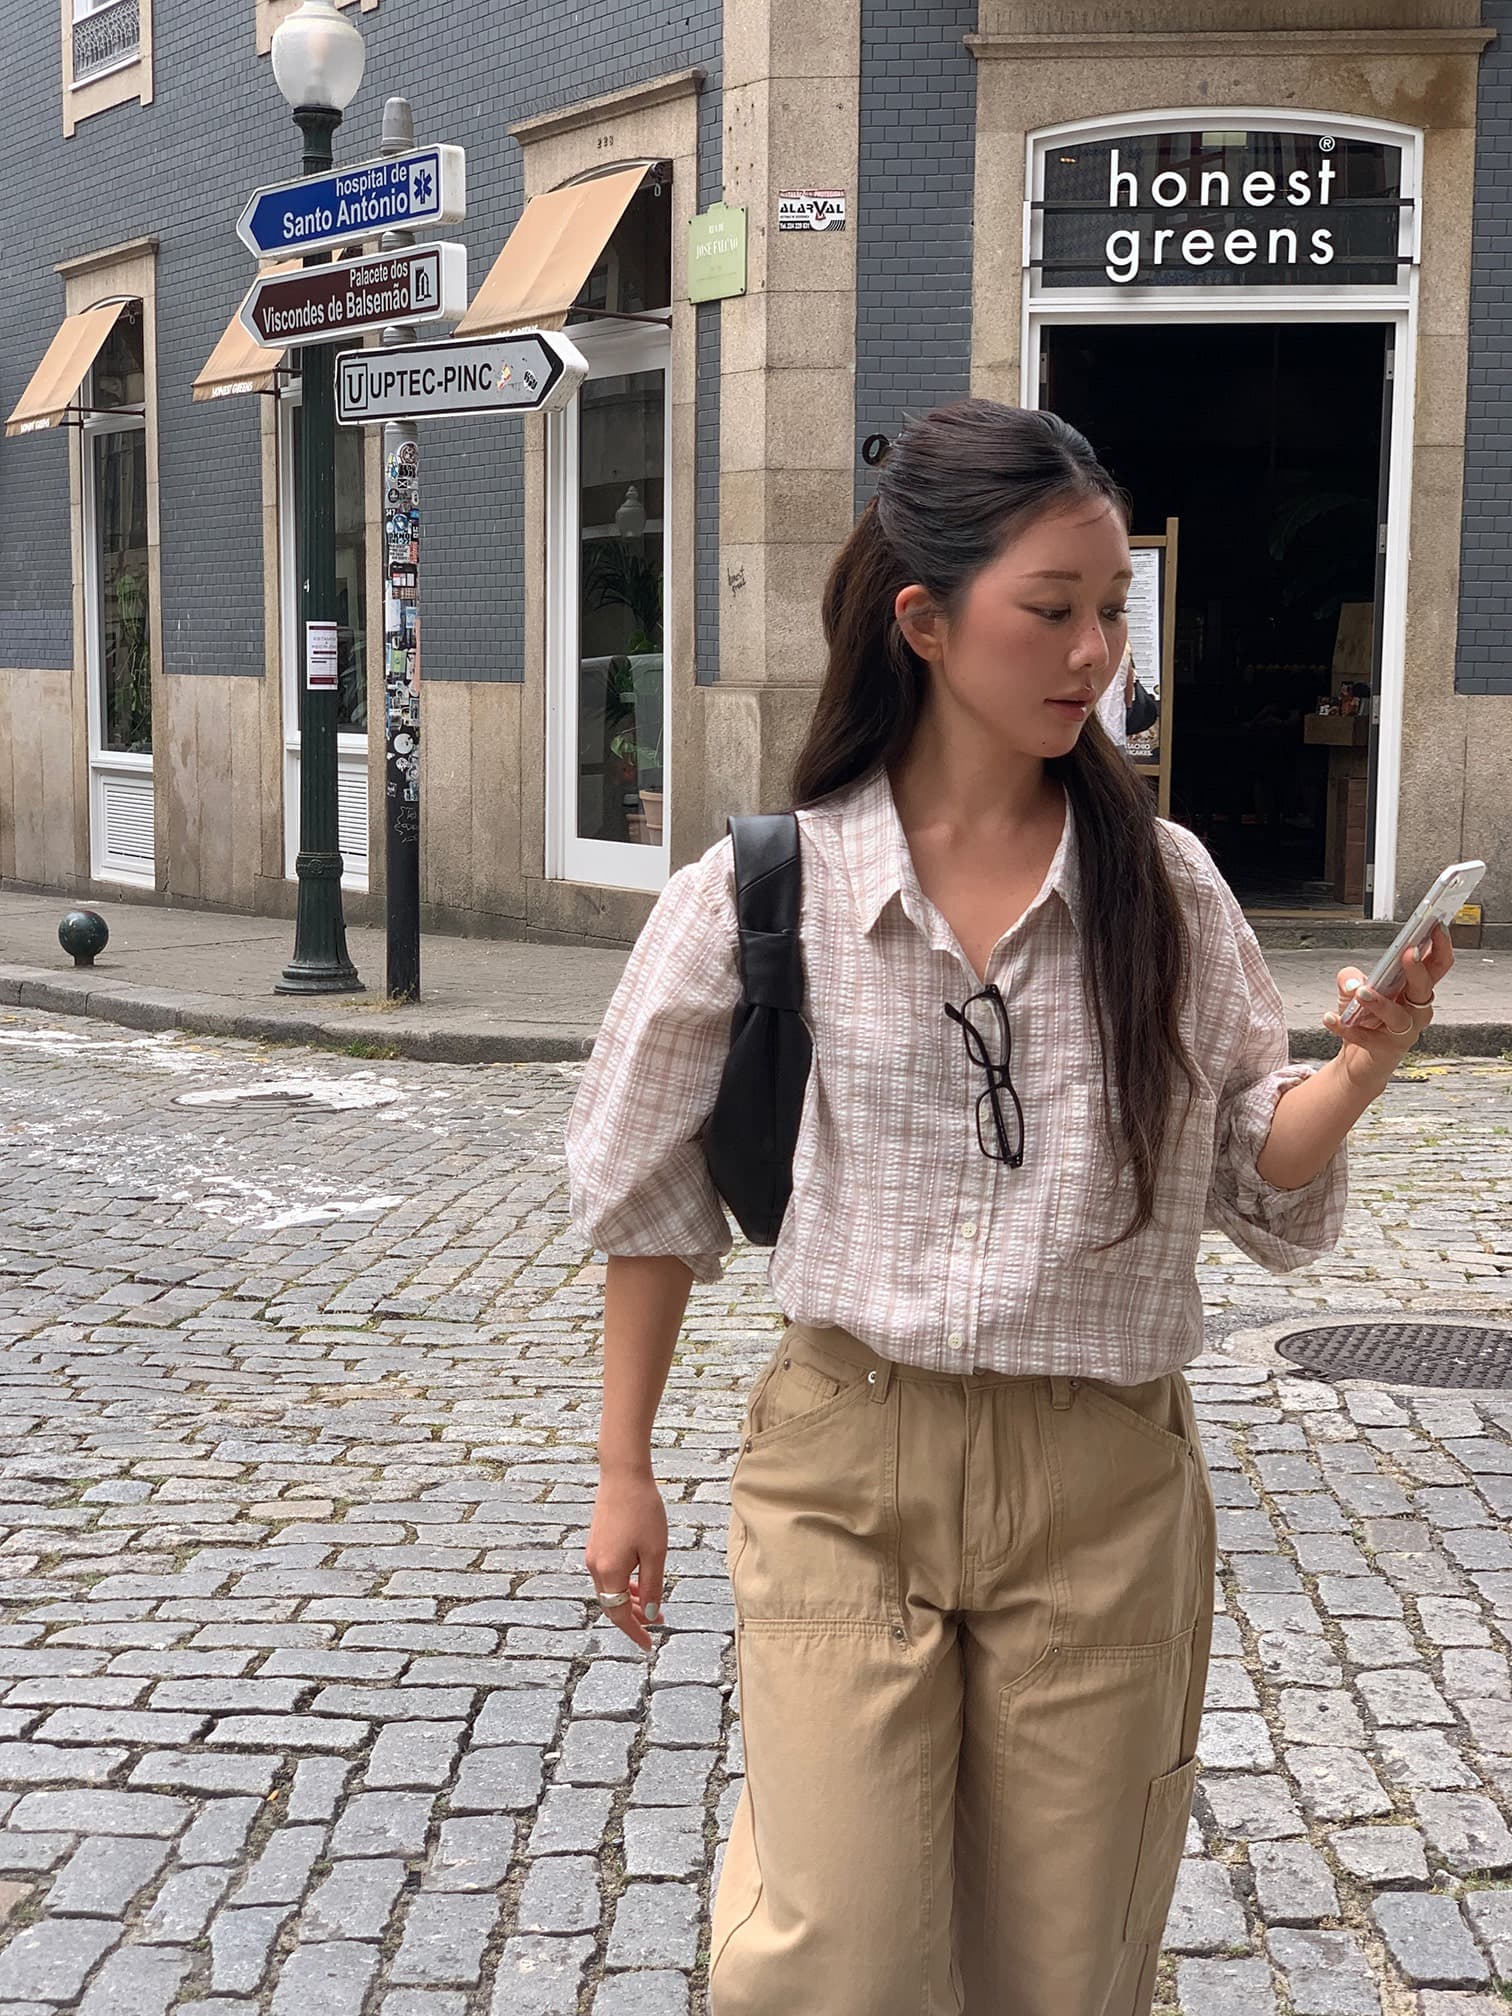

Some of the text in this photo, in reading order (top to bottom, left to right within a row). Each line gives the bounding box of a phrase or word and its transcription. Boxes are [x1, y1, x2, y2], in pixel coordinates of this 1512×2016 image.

[336, 163, 407, 197] hospital de
[1110, 149, 1335, 207] honest
[283, 188, 408, 239] Santo António
[780, 201, 844, 216] ALARVAL
[350, 260, 408, 287] Palacete dos
[1106, 229, 1334, 283] greens
[263, 283, 408, 333] Viscondes de Balsemão
[370, 363, 492, 398] UPTEC-PINC
